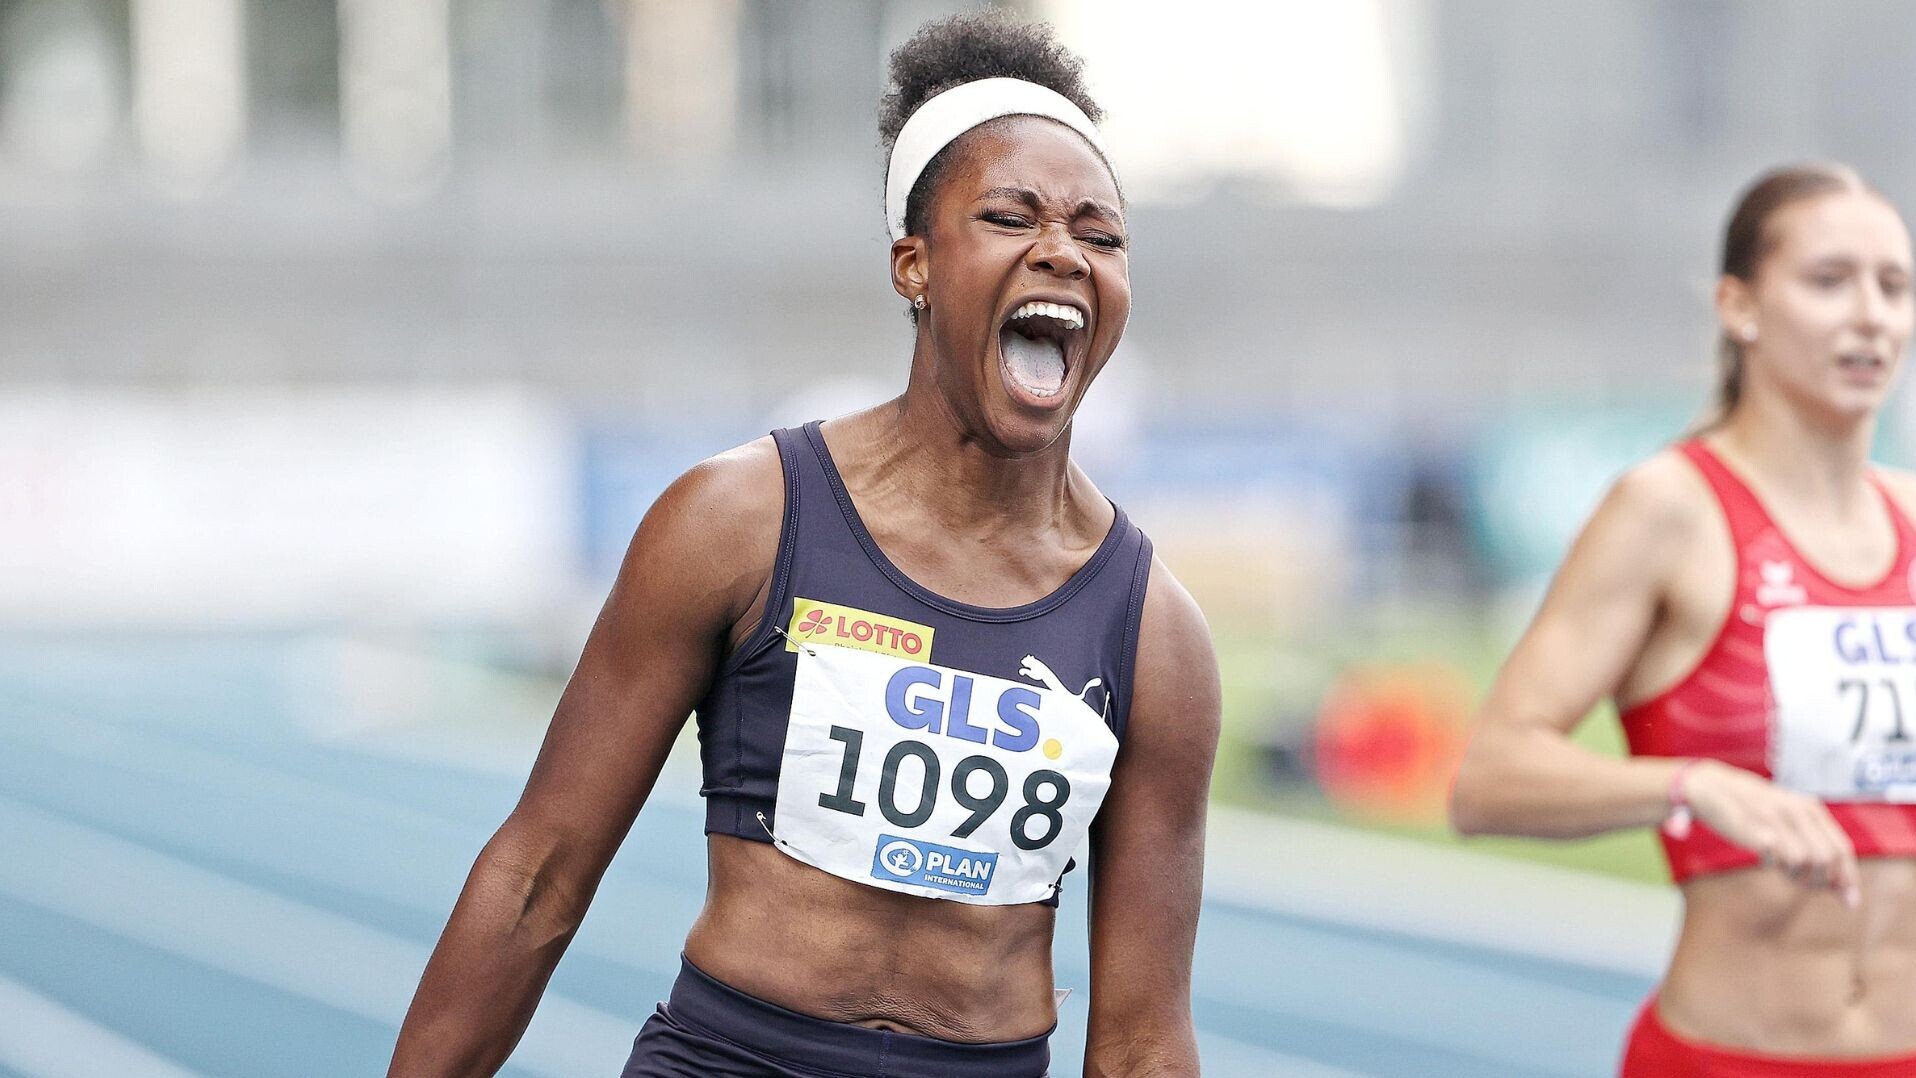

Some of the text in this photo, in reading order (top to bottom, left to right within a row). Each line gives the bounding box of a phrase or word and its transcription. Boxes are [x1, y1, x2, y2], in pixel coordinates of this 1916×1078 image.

[836, 615, 923, 655] LOTTO
[818, 724, 1071, 851] 1098
[924, 874, 985, 890] INTERNATIONAL
[925, 851, 992, 881] PLAN
